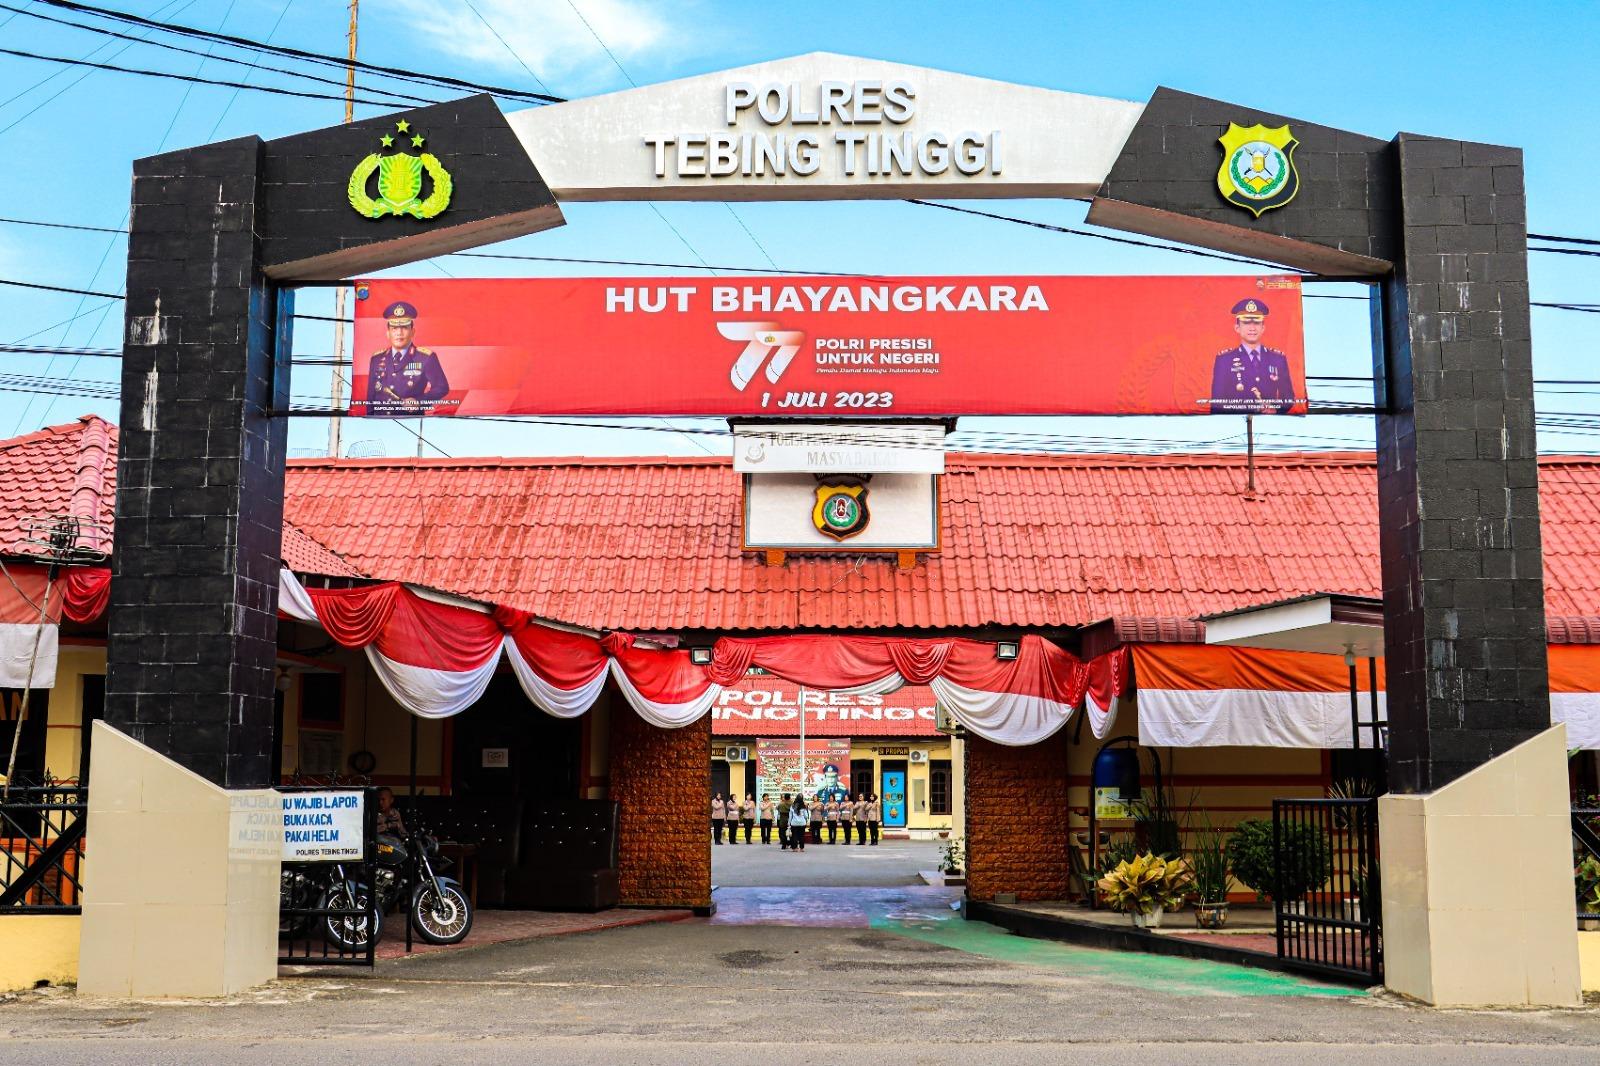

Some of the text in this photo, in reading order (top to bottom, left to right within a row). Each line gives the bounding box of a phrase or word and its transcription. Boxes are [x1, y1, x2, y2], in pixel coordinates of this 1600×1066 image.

[725, 80, 916, 126] POLRES
[644, 130, 1003, 178] TEBING TINGGI
[606, 285, 1050, 313] HUT BHAYANGKARA
[816, 338, 932, 350] POLRI PRESISI
[716, 321, 805, 392] 77
[816, 352, 940, 364] UNTUK NEGERI
[761, 391, 894, 408] 1 JULI 2023
[719, 690, 884, 706] POLRES
[283, 796, 358, 810] U WAJIB LAPOR
[283, 813, 333, 826] BUKA KACA
[285, 829, 339, 842] PAKAI HELM
[296, 848, 320, 856] POLRES
